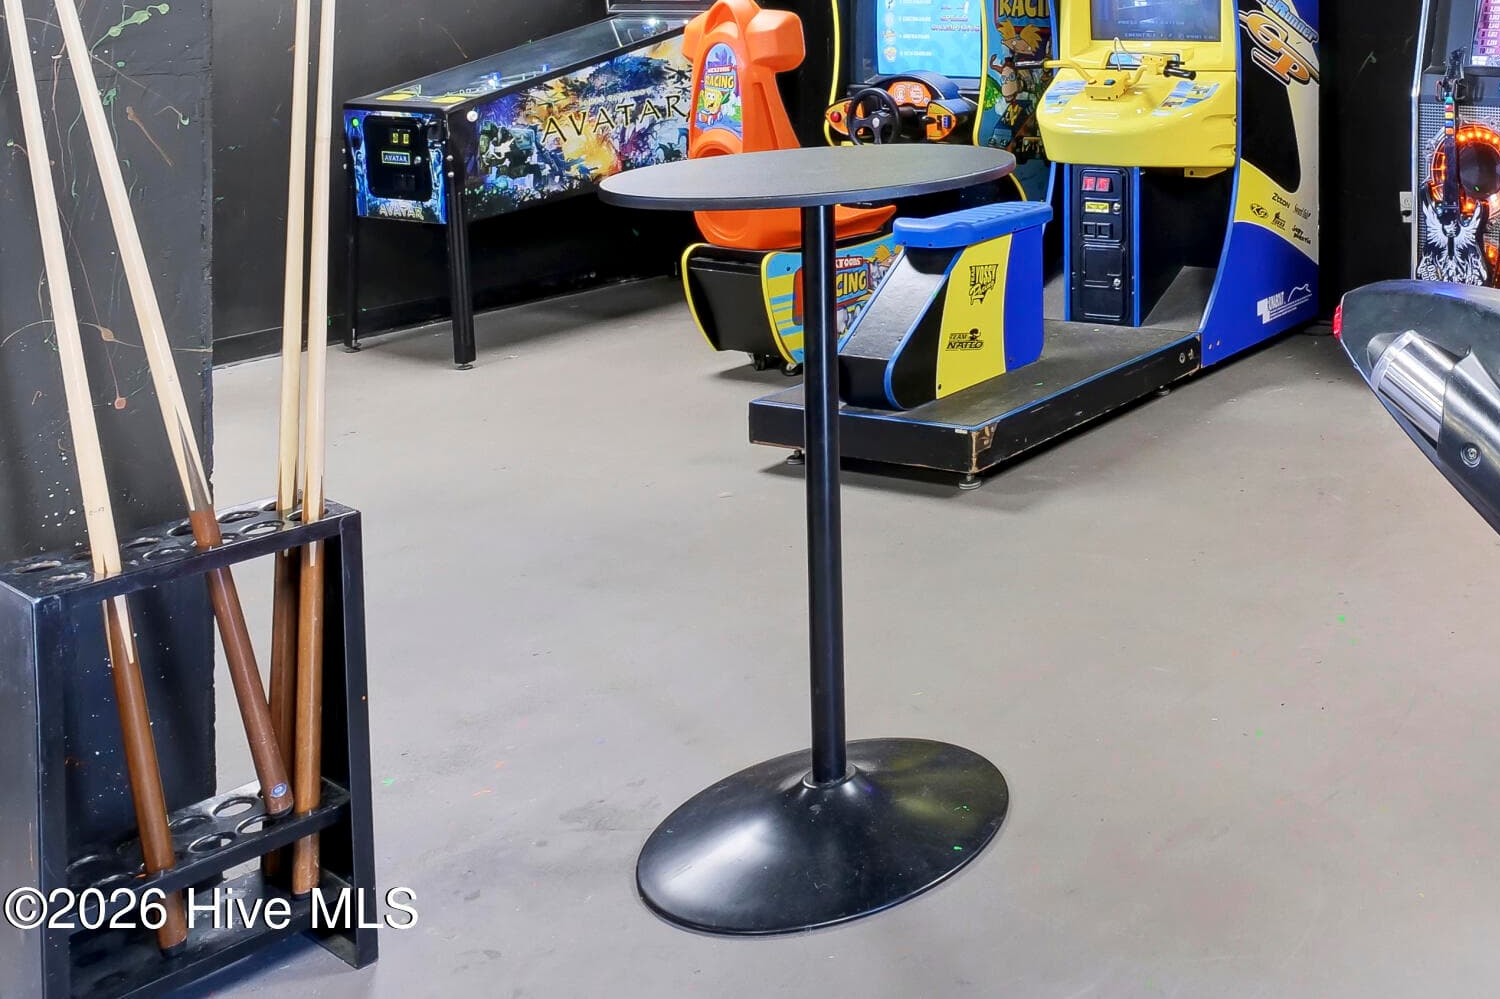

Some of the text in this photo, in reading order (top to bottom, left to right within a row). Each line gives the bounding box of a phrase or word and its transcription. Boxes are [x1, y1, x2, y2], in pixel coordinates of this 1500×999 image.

[705, 74, 735, 89] RACING
[541, 94, 688, 144] AVATAR
[384, 154, 407, 162] AVATAR
[379, 204, 425, 221] AVATAR
[836, 270, 867, 297] CING
